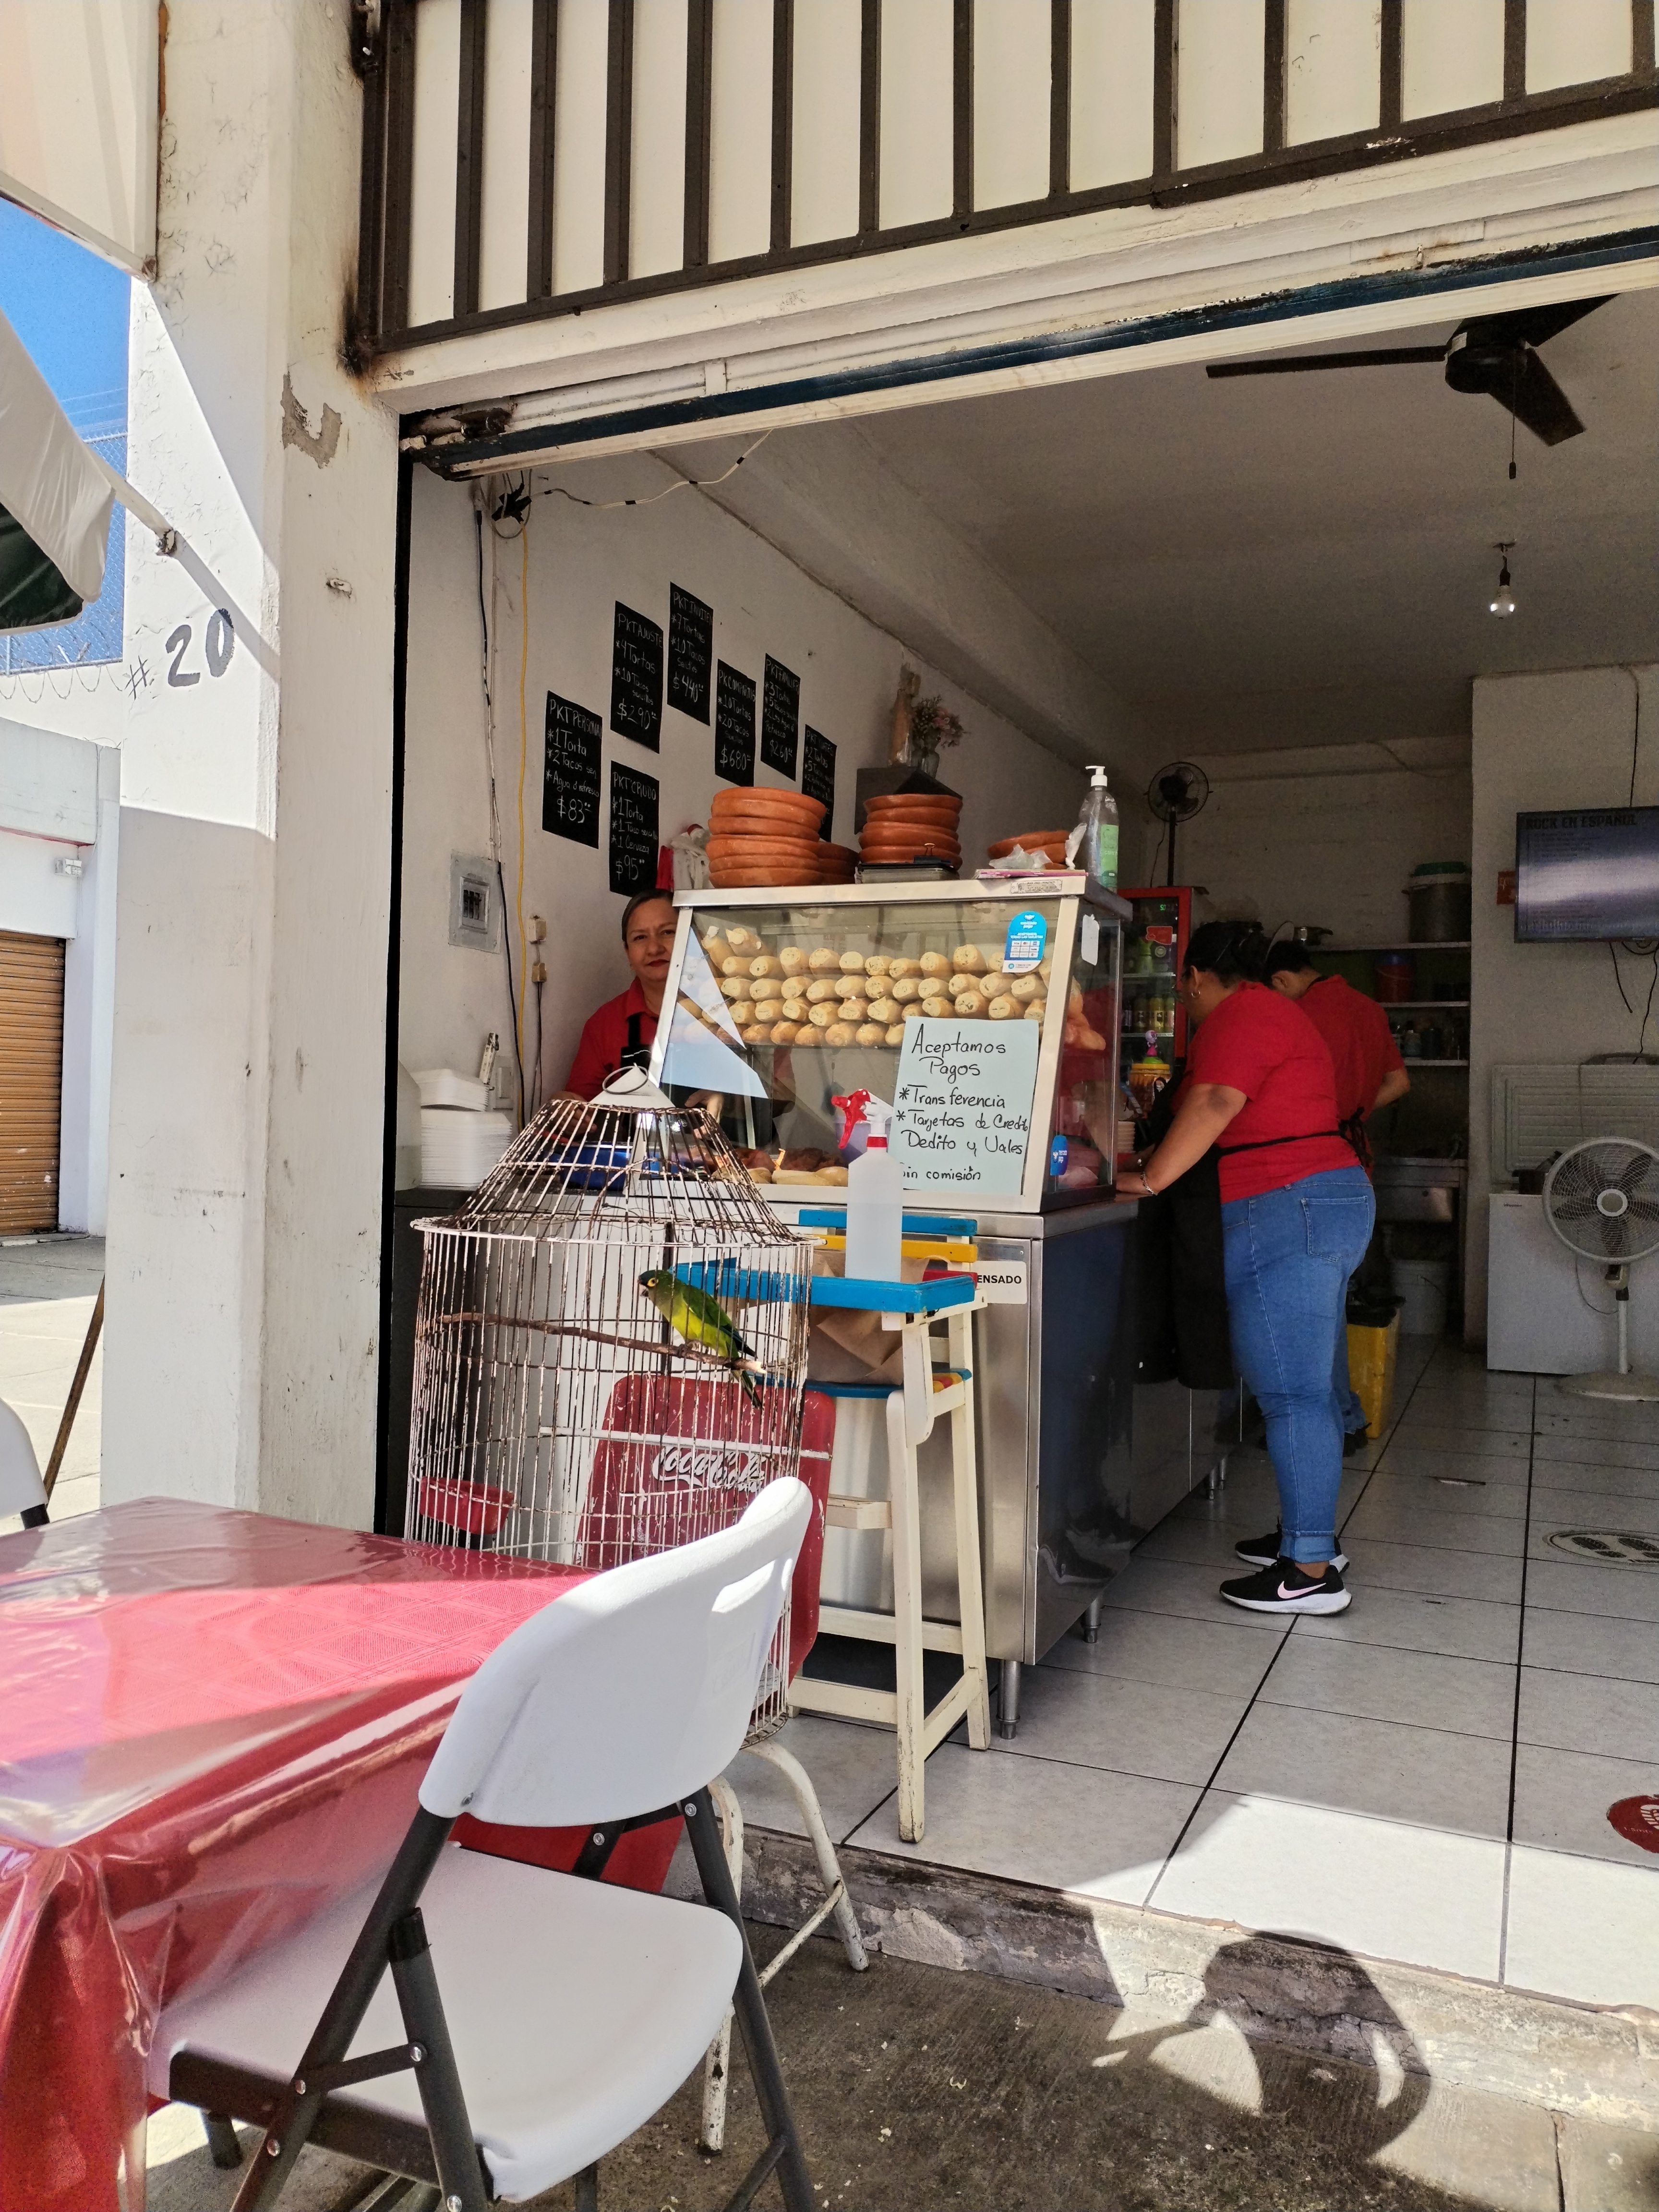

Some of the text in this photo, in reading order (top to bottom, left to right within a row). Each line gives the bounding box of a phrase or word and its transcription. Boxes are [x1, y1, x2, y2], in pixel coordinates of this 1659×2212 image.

[673, 592, 689, 610] PKT
[617, 613, 637, 633] PKT
[627, 643, 656, 673] Tortas
[549, 699, 573, 724] PKT
[561, 729, 587, 757] Torta
[561, 752, 583, 771] Tacos
[613, 771, 630, 790] PKT
[625, 799, 643, 823] Torta
[912, 1023, 1006, 1058] Aceptamos
[919, 1056, 981, 1084] Pagos
[975, 1113, 991, 1129] de
[900, 1162, 918, 1179] in
[977, 1275, 1022, 1284] ENSADO
